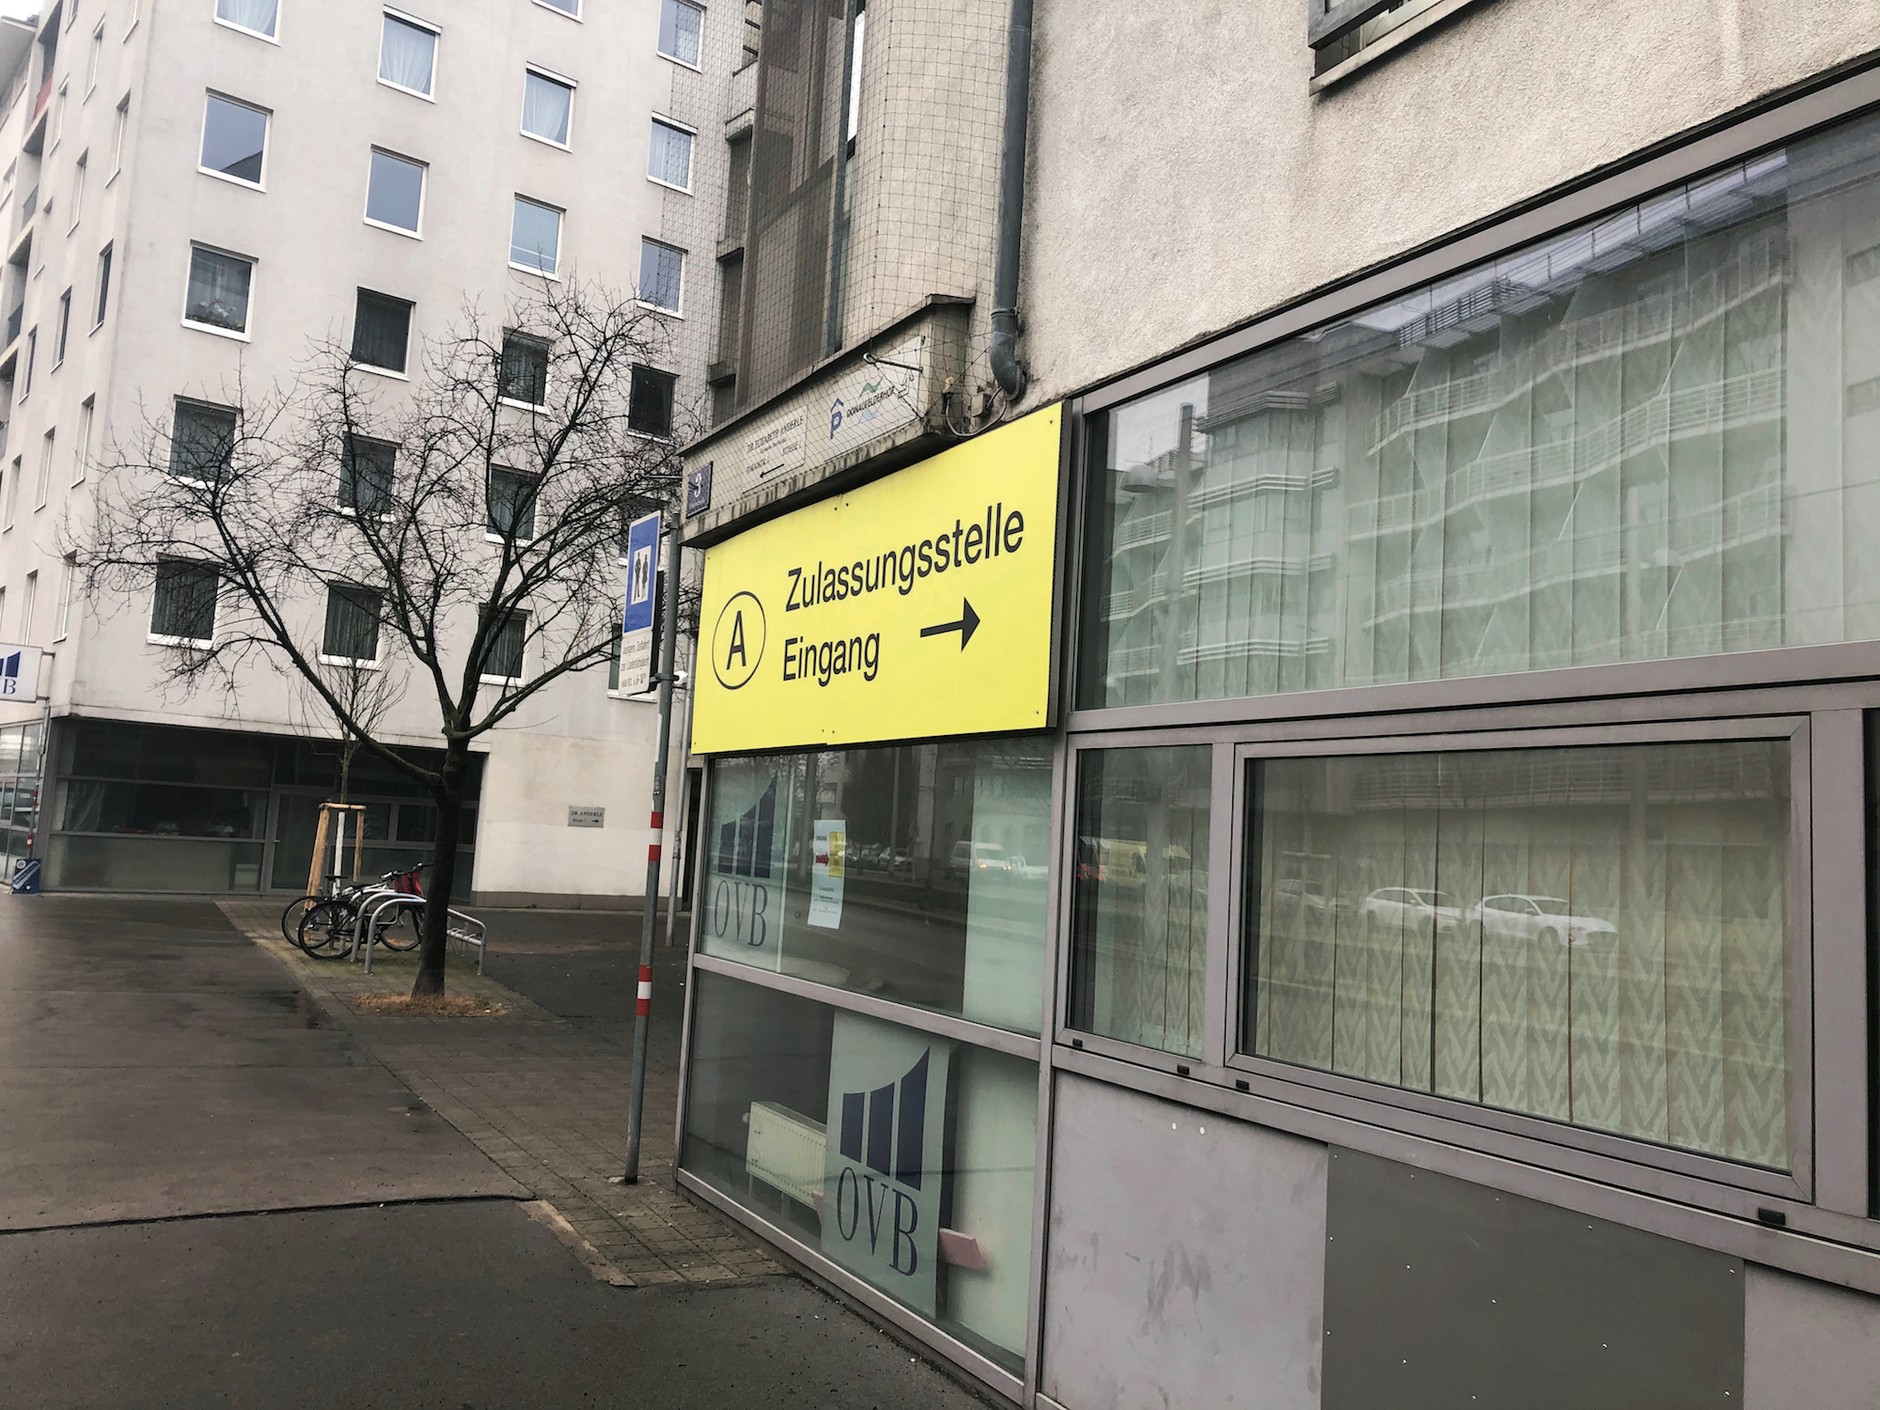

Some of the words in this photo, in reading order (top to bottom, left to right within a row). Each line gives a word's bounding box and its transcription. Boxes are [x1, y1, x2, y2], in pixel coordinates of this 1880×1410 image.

[693, 472, 702, 498] 3
[786, 502, 1024, 612] Zulassungsstelle
[726, 610, 747, 671] A
[783, 632, 880, 687] Eingang
[714, 880, 768, 947] OVB
[836, 1166, 919, 1277] OVB
